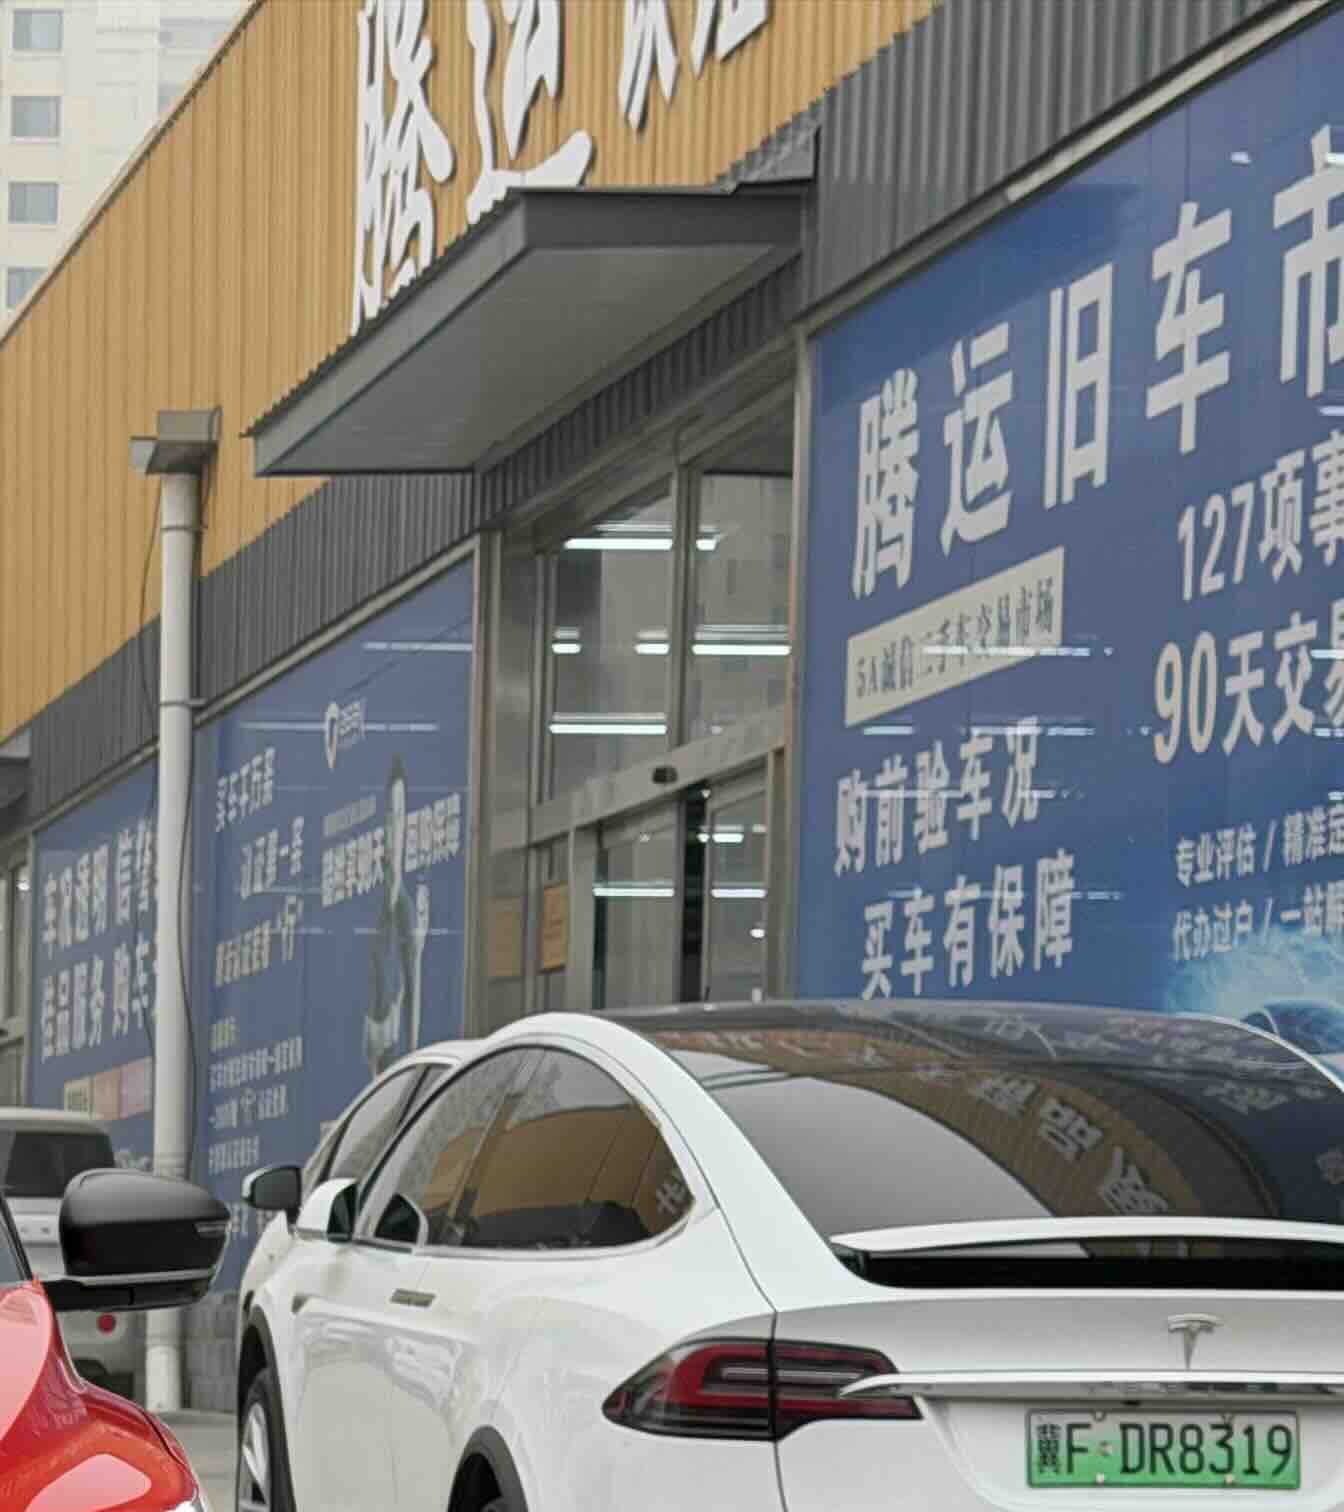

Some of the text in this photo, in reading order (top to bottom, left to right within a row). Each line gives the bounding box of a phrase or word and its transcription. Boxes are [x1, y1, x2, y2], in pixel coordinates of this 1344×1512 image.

[852, 124, 1344, 599] 腾运旧车市
[834, 716, 1040, 877] 购前验车况
[861, 847, 1075, 1000] 买车有保障
